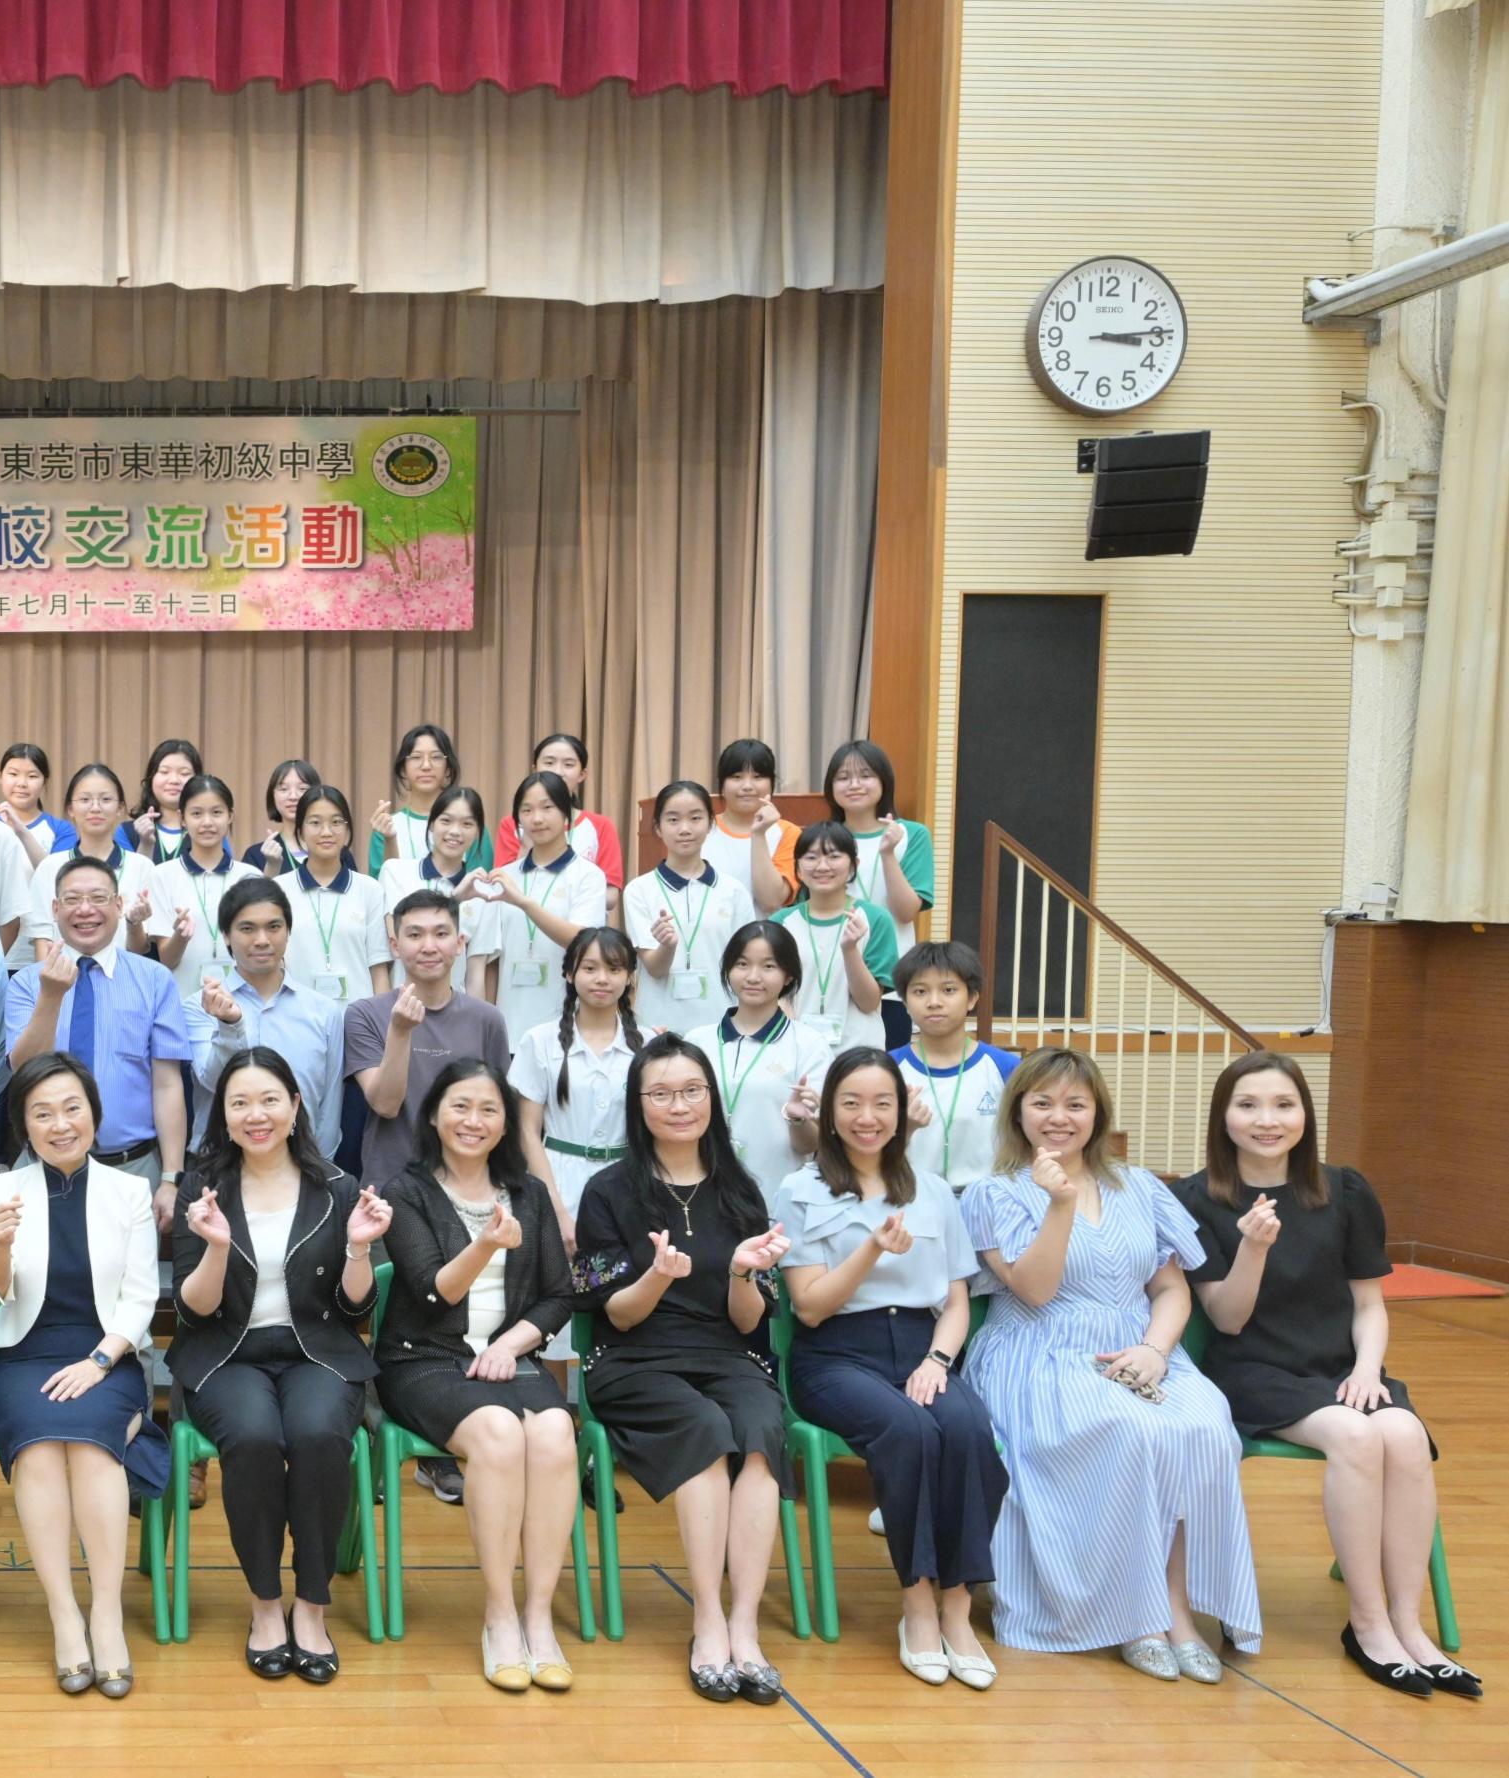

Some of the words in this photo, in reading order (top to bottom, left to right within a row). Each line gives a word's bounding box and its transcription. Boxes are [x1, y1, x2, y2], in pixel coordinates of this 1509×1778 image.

[1077, 281, 1093, 302] 11
[1099, 276, 1120, 297] 12
[1131, 281, 1137, 303] 1
[1055, 301, 1076, 322] 10
[1095, 306, 1124, 314] SEIKO
[1143, 300, 1159, 321] 2
[1047, 326, 1063, 348] 9
[1148, 326, 1165, 347] 3
[1055, 350, 1071, 371] 8
[1139, 351, 1156, 372] 4
[1074, 371, 1089, 391] 7
[1095, 376, 1111, 398] 6
[1120, 370, 1136, 391] 5
[0, 442, 353, 480] 東莞市東華初級中學
